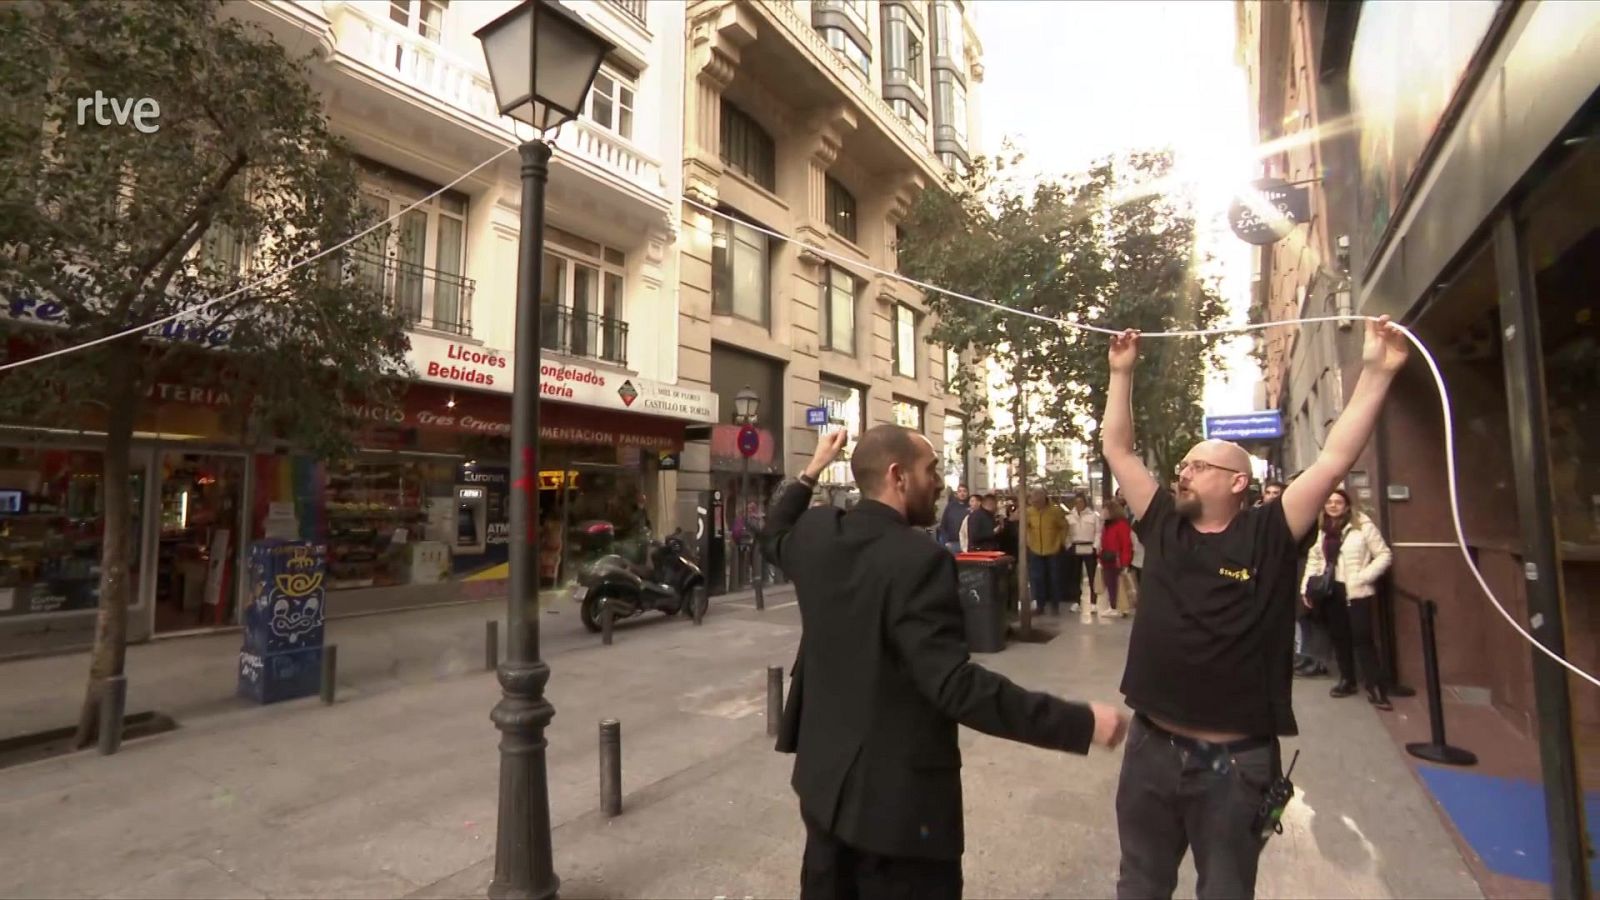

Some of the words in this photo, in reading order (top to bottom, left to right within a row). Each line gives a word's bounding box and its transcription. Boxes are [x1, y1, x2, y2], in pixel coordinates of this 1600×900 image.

[447, 344, 507, 369] Licores
[427, 361, 495, 386] Bebidas
[540, 365, 606, 387] ongelados
[644, 399, 678, 412] CASTILLO
[679, 404, 688, 413] DE
[417, 410, 455, 426] Tres
